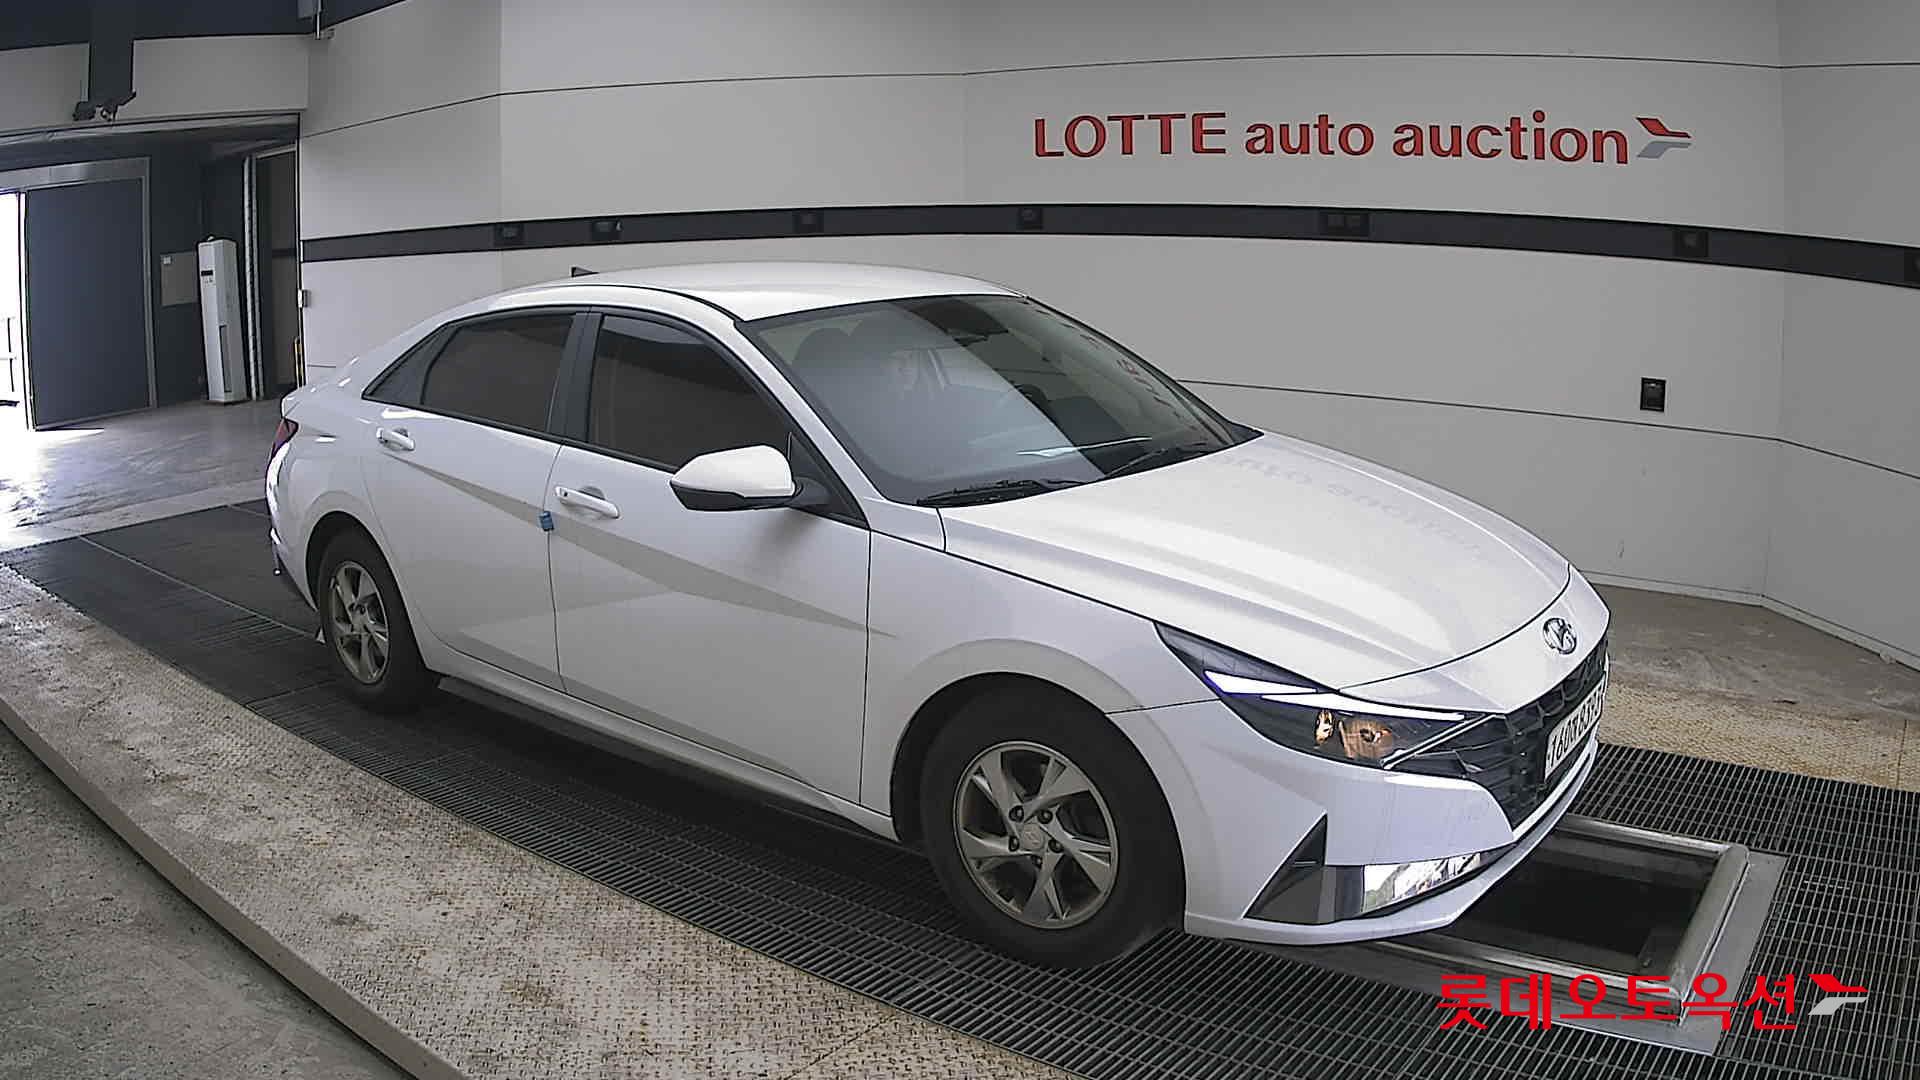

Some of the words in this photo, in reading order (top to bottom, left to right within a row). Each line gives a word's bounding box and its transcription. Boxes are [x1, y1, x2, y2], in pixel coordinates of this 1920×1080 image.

[1033, 112, 1227, 158] LOTTE
[1244, 113, 1376, 156] auto
[1391, 110, 1629, 165] auction
